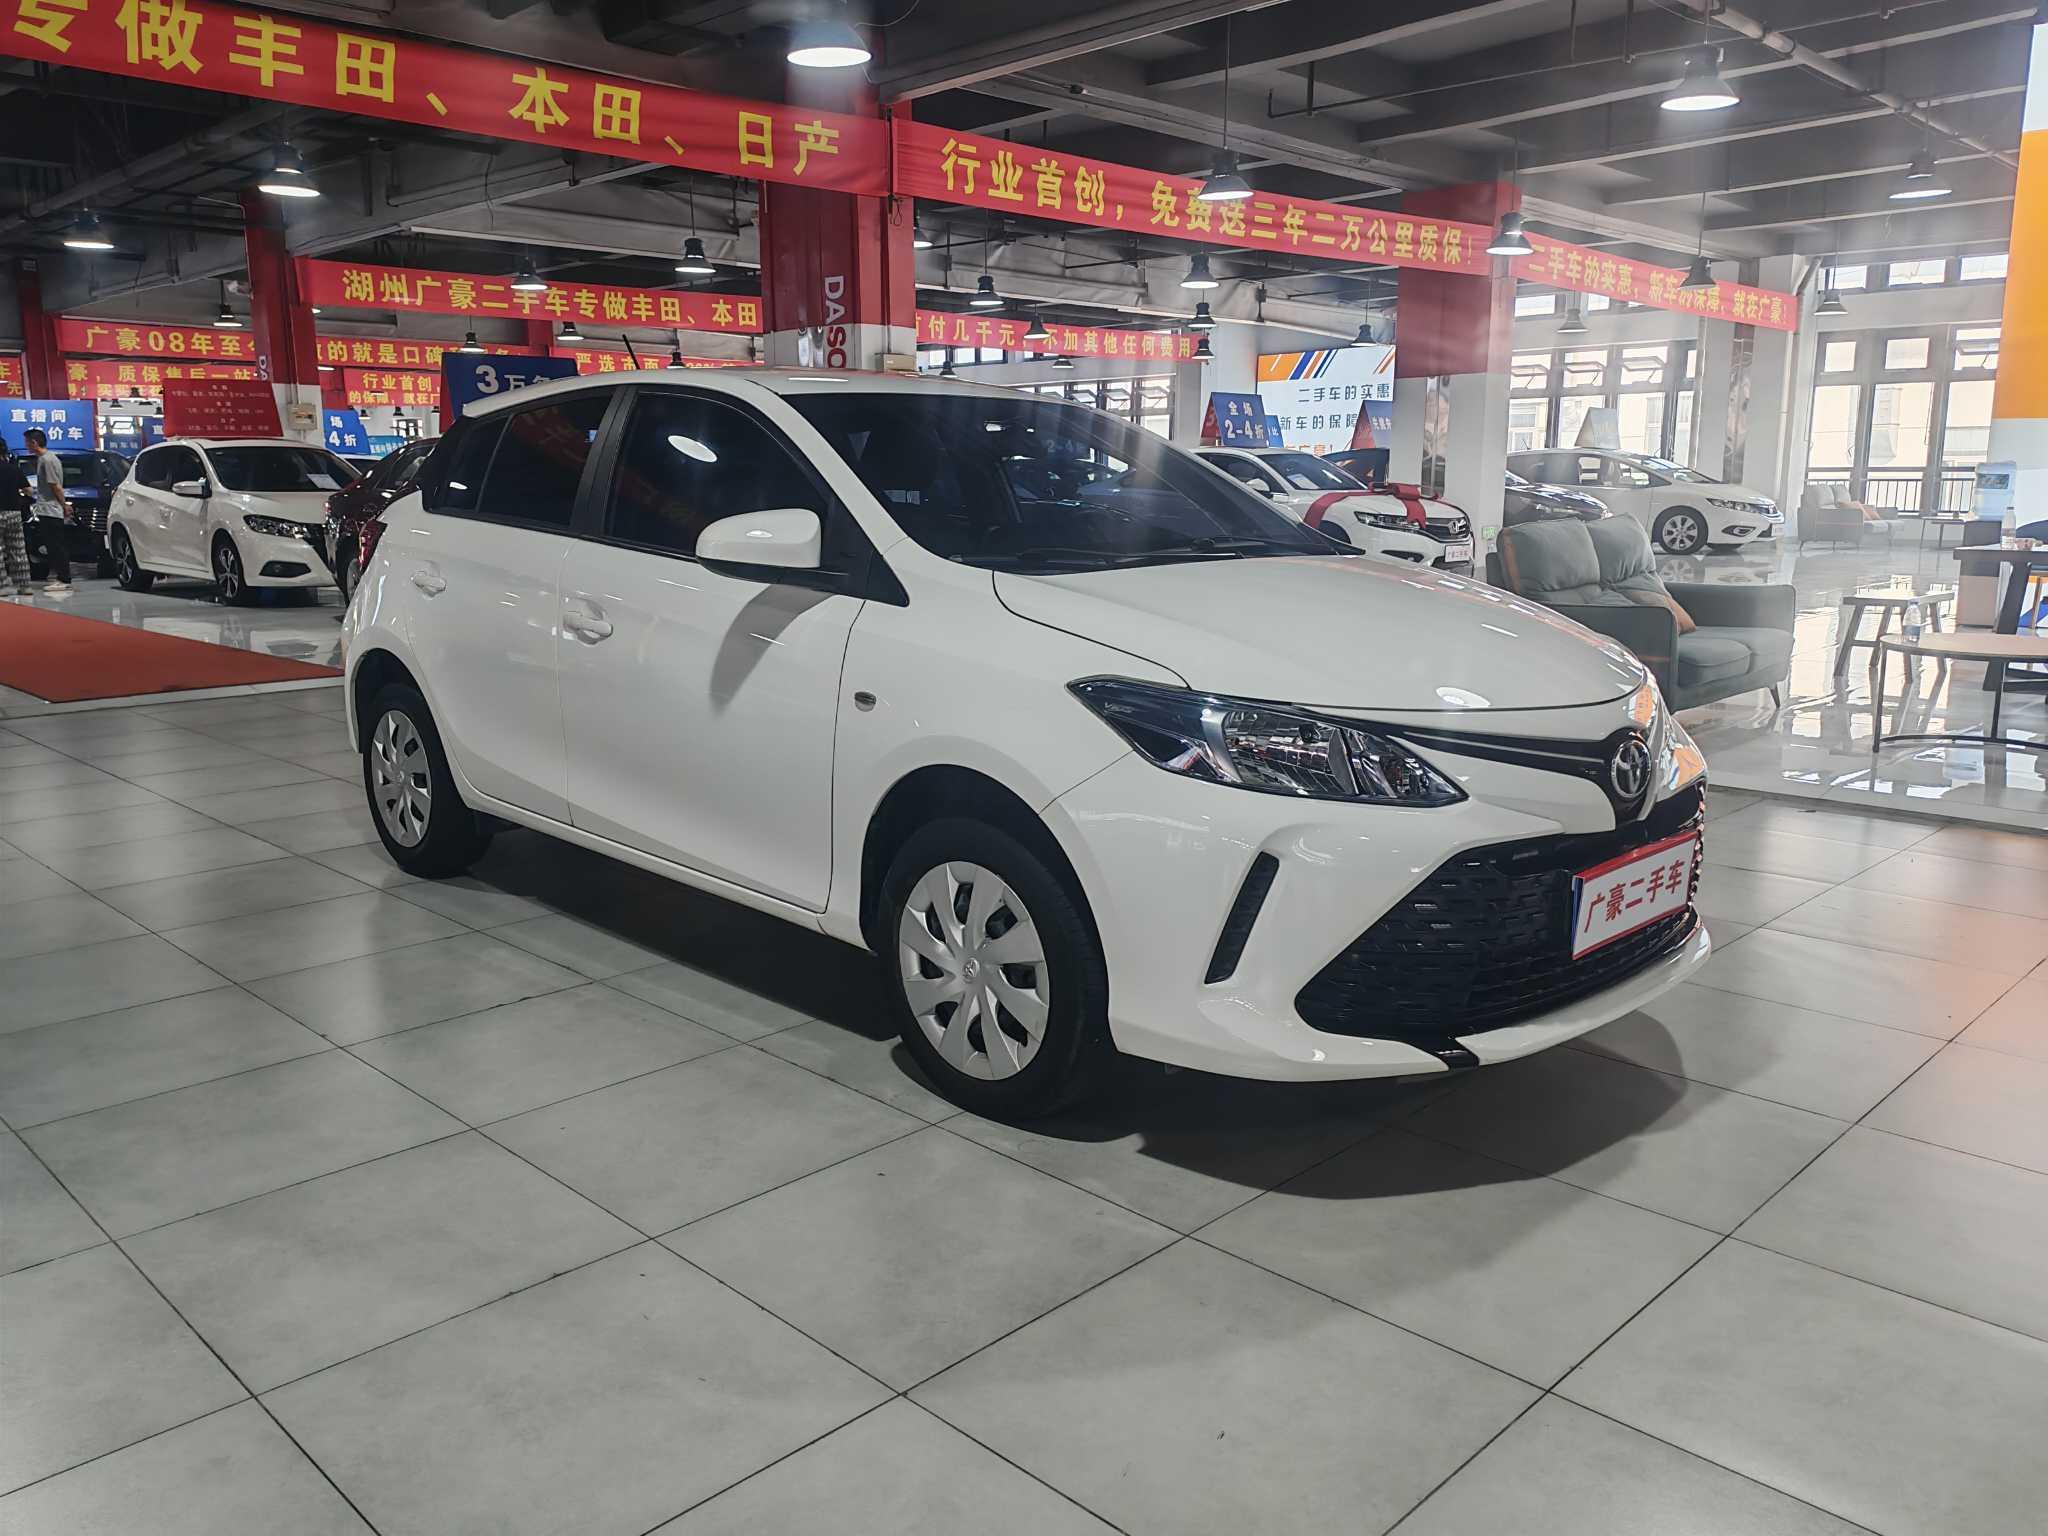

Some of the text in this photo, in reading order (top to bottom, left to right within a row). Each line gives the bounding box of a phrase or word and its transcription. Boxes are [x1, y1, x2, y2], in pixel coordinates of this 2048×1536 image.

[917, 312, 1191, 359] 付几千元，不加其他任何费用
[316, 340, 443, 365] 的就是口碑
[1298, 383, 1390, 402] 二手车的实惠
[11, 408, 66, 423] 直播间
[1227, 400, 1254, 417] 全场
[28, 426, 84, 441] 价车
[328, 431, 357, 447] 4折
[1584, 859, 1686, 933] 广豪二手车
